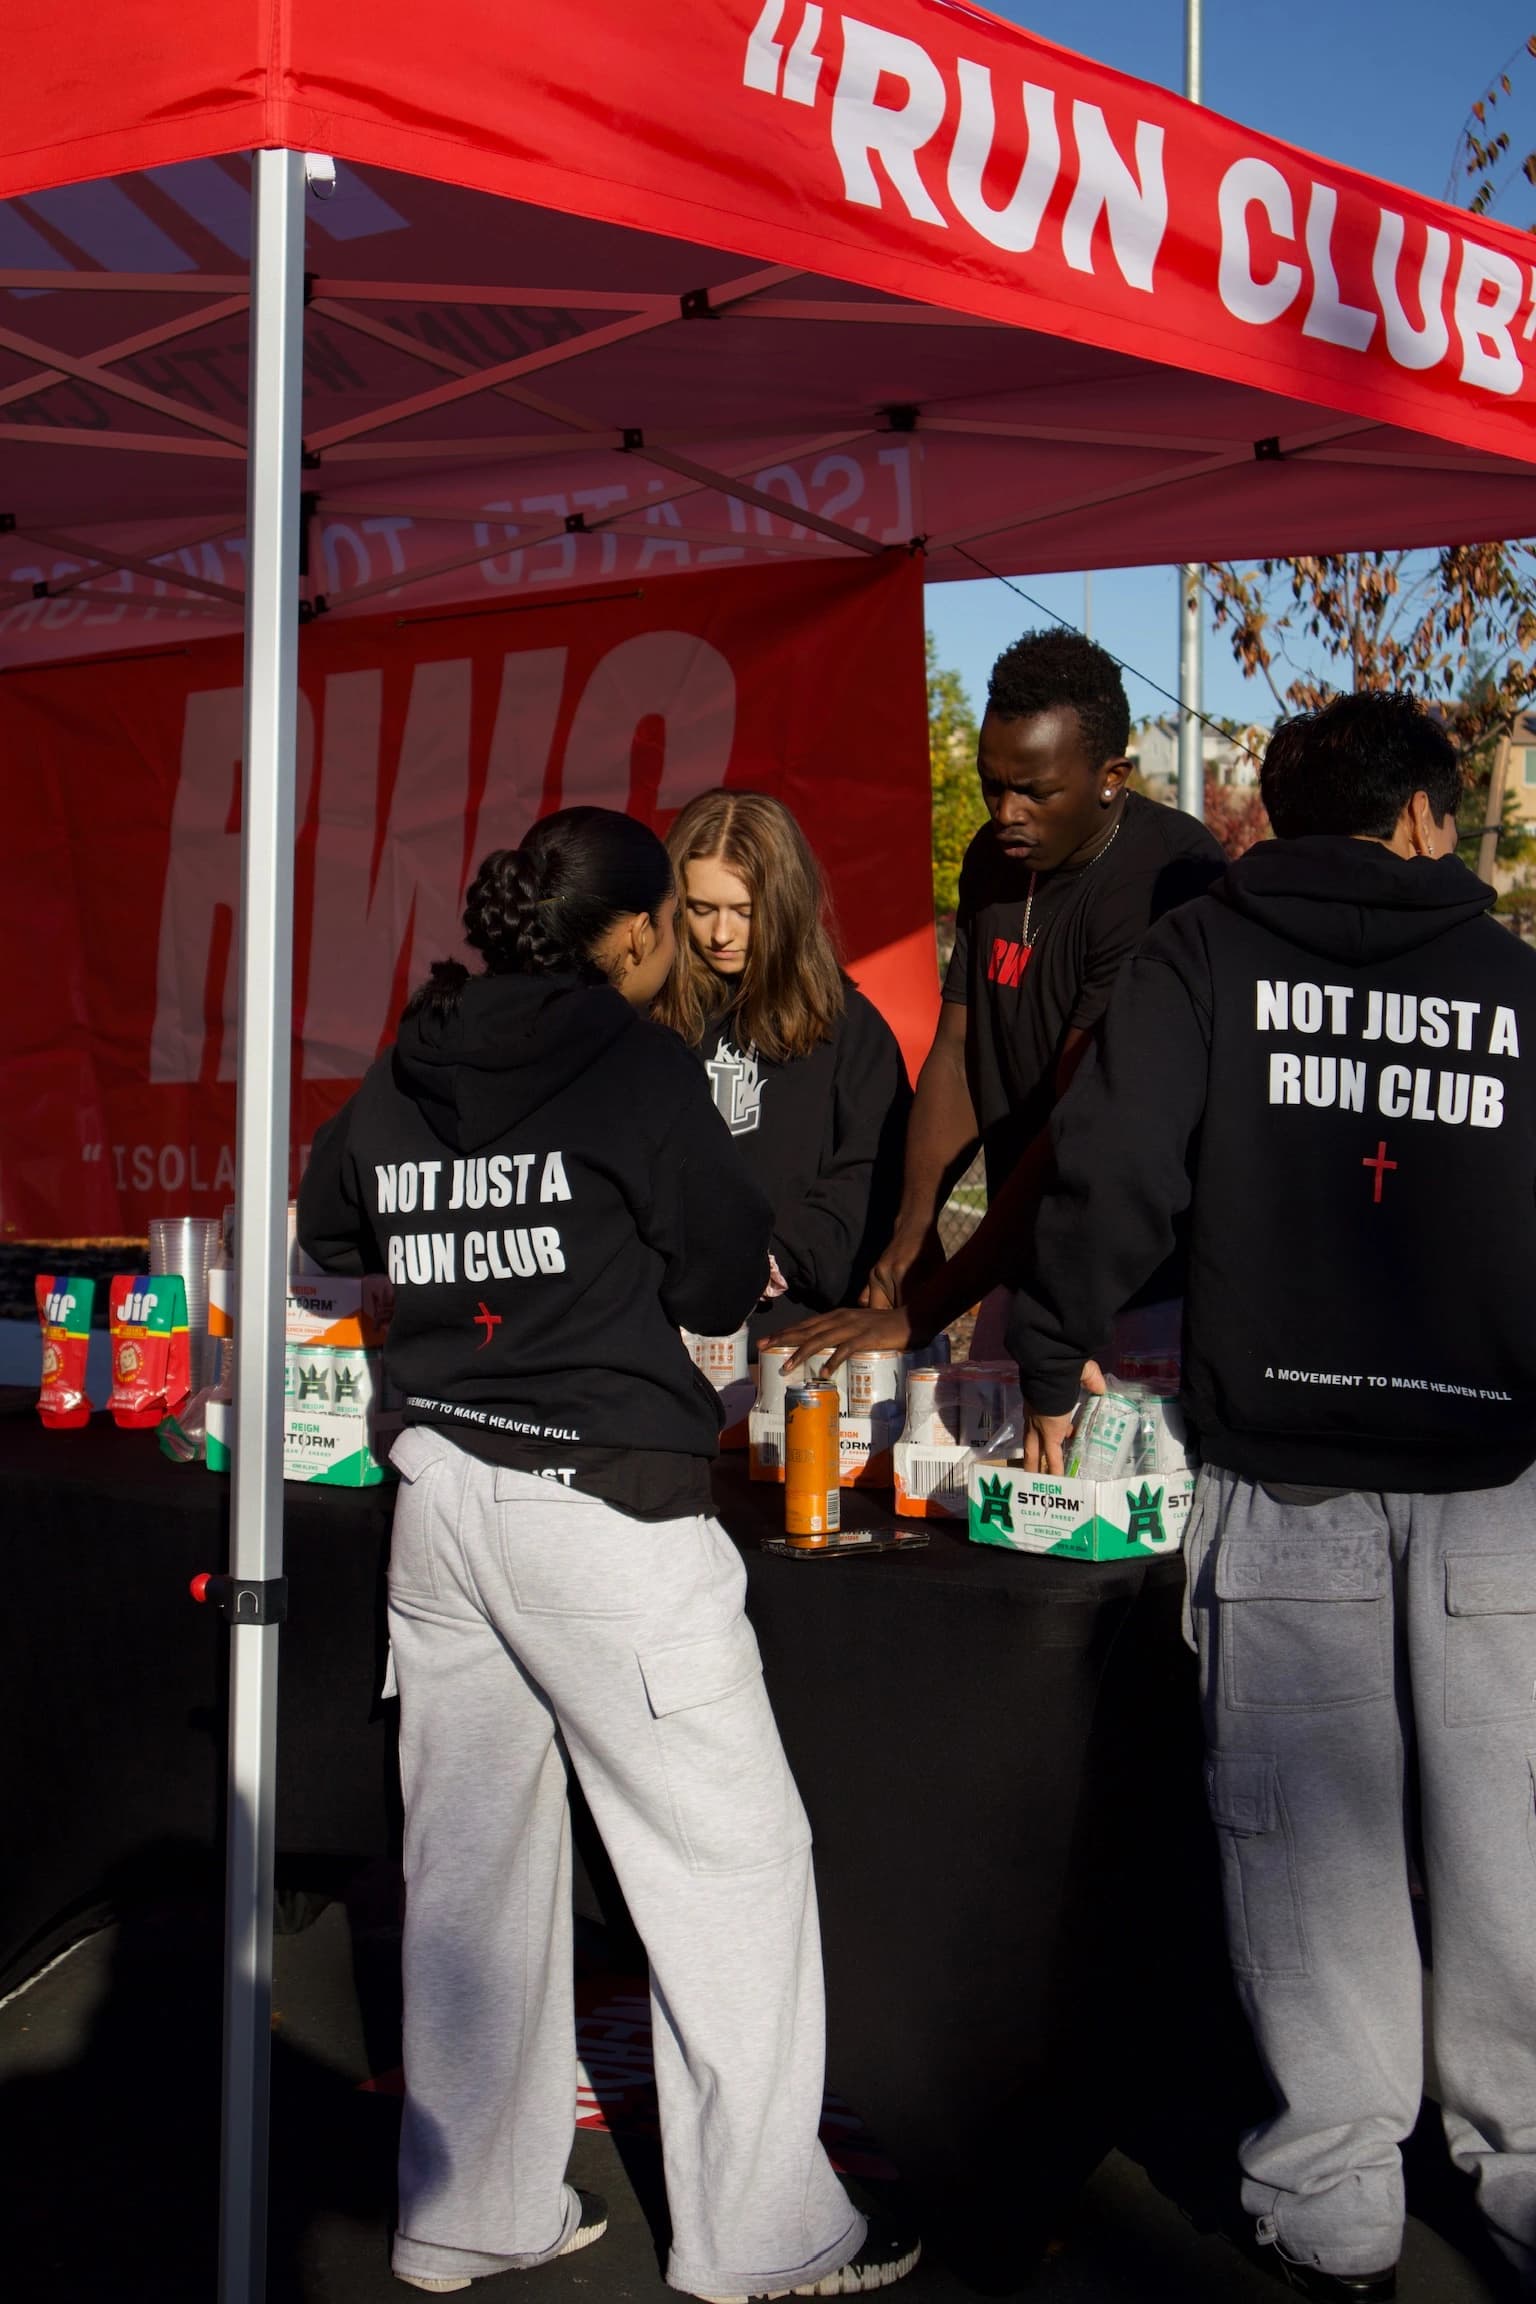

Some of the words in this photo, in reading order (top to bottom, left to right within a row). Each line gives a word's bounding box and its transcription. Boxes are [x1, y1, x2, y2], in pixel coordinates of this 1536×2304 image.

[1218, 157, 1536, 396] CLUB
[1256, 980, 1354, 1035] NOT
[1362, 990, 1481, 1051] JUST
[1488, 1005, 1520, 1058] A
[1269, 1053, 1367, 1113] RUN
[1378, 1064, 1505, 1129] CLUB
[375, 1161, 441, 1214] NOT
[449, 1153, 536, 1210] JUST
[540, 1151, 573, 1203] A
[388, 1232, 456, 1285] RUN
[464, 1226, 566, 1284] CLUB
[117, 1293, 158, 1322] Jif
[285, 1297, 333, 1312] TORM
[1265, 1367, 1274, 1378] A
[1278, 1369, 1363, 1386] MOVEMENT
[1367, 1376, 1387, 1387] TO
[1392, 1377, 1429, 1390] MAKE
[1431, 1382, 1477, 1398] HEAVEN
[1479, 1389, 1512, 1401] FULL
[291, 1422, 320, 1433] REIGN
[439, 1404, 452, 1414] TO
[454, 1407, 487, 1424] MAKE
[489, 1415, 540, 1436] HEAVEN
[544, 1428, 580, 1440] FULL
[839, 1431, 859, 1439] EIGN
[283, 1433, 335, 1449] TORM
[839, 1440, 872, 1451] ORM
[1017, 1492, 1080, 1512] STORM
[1032, 1481, 1062, 1496] REIGN
